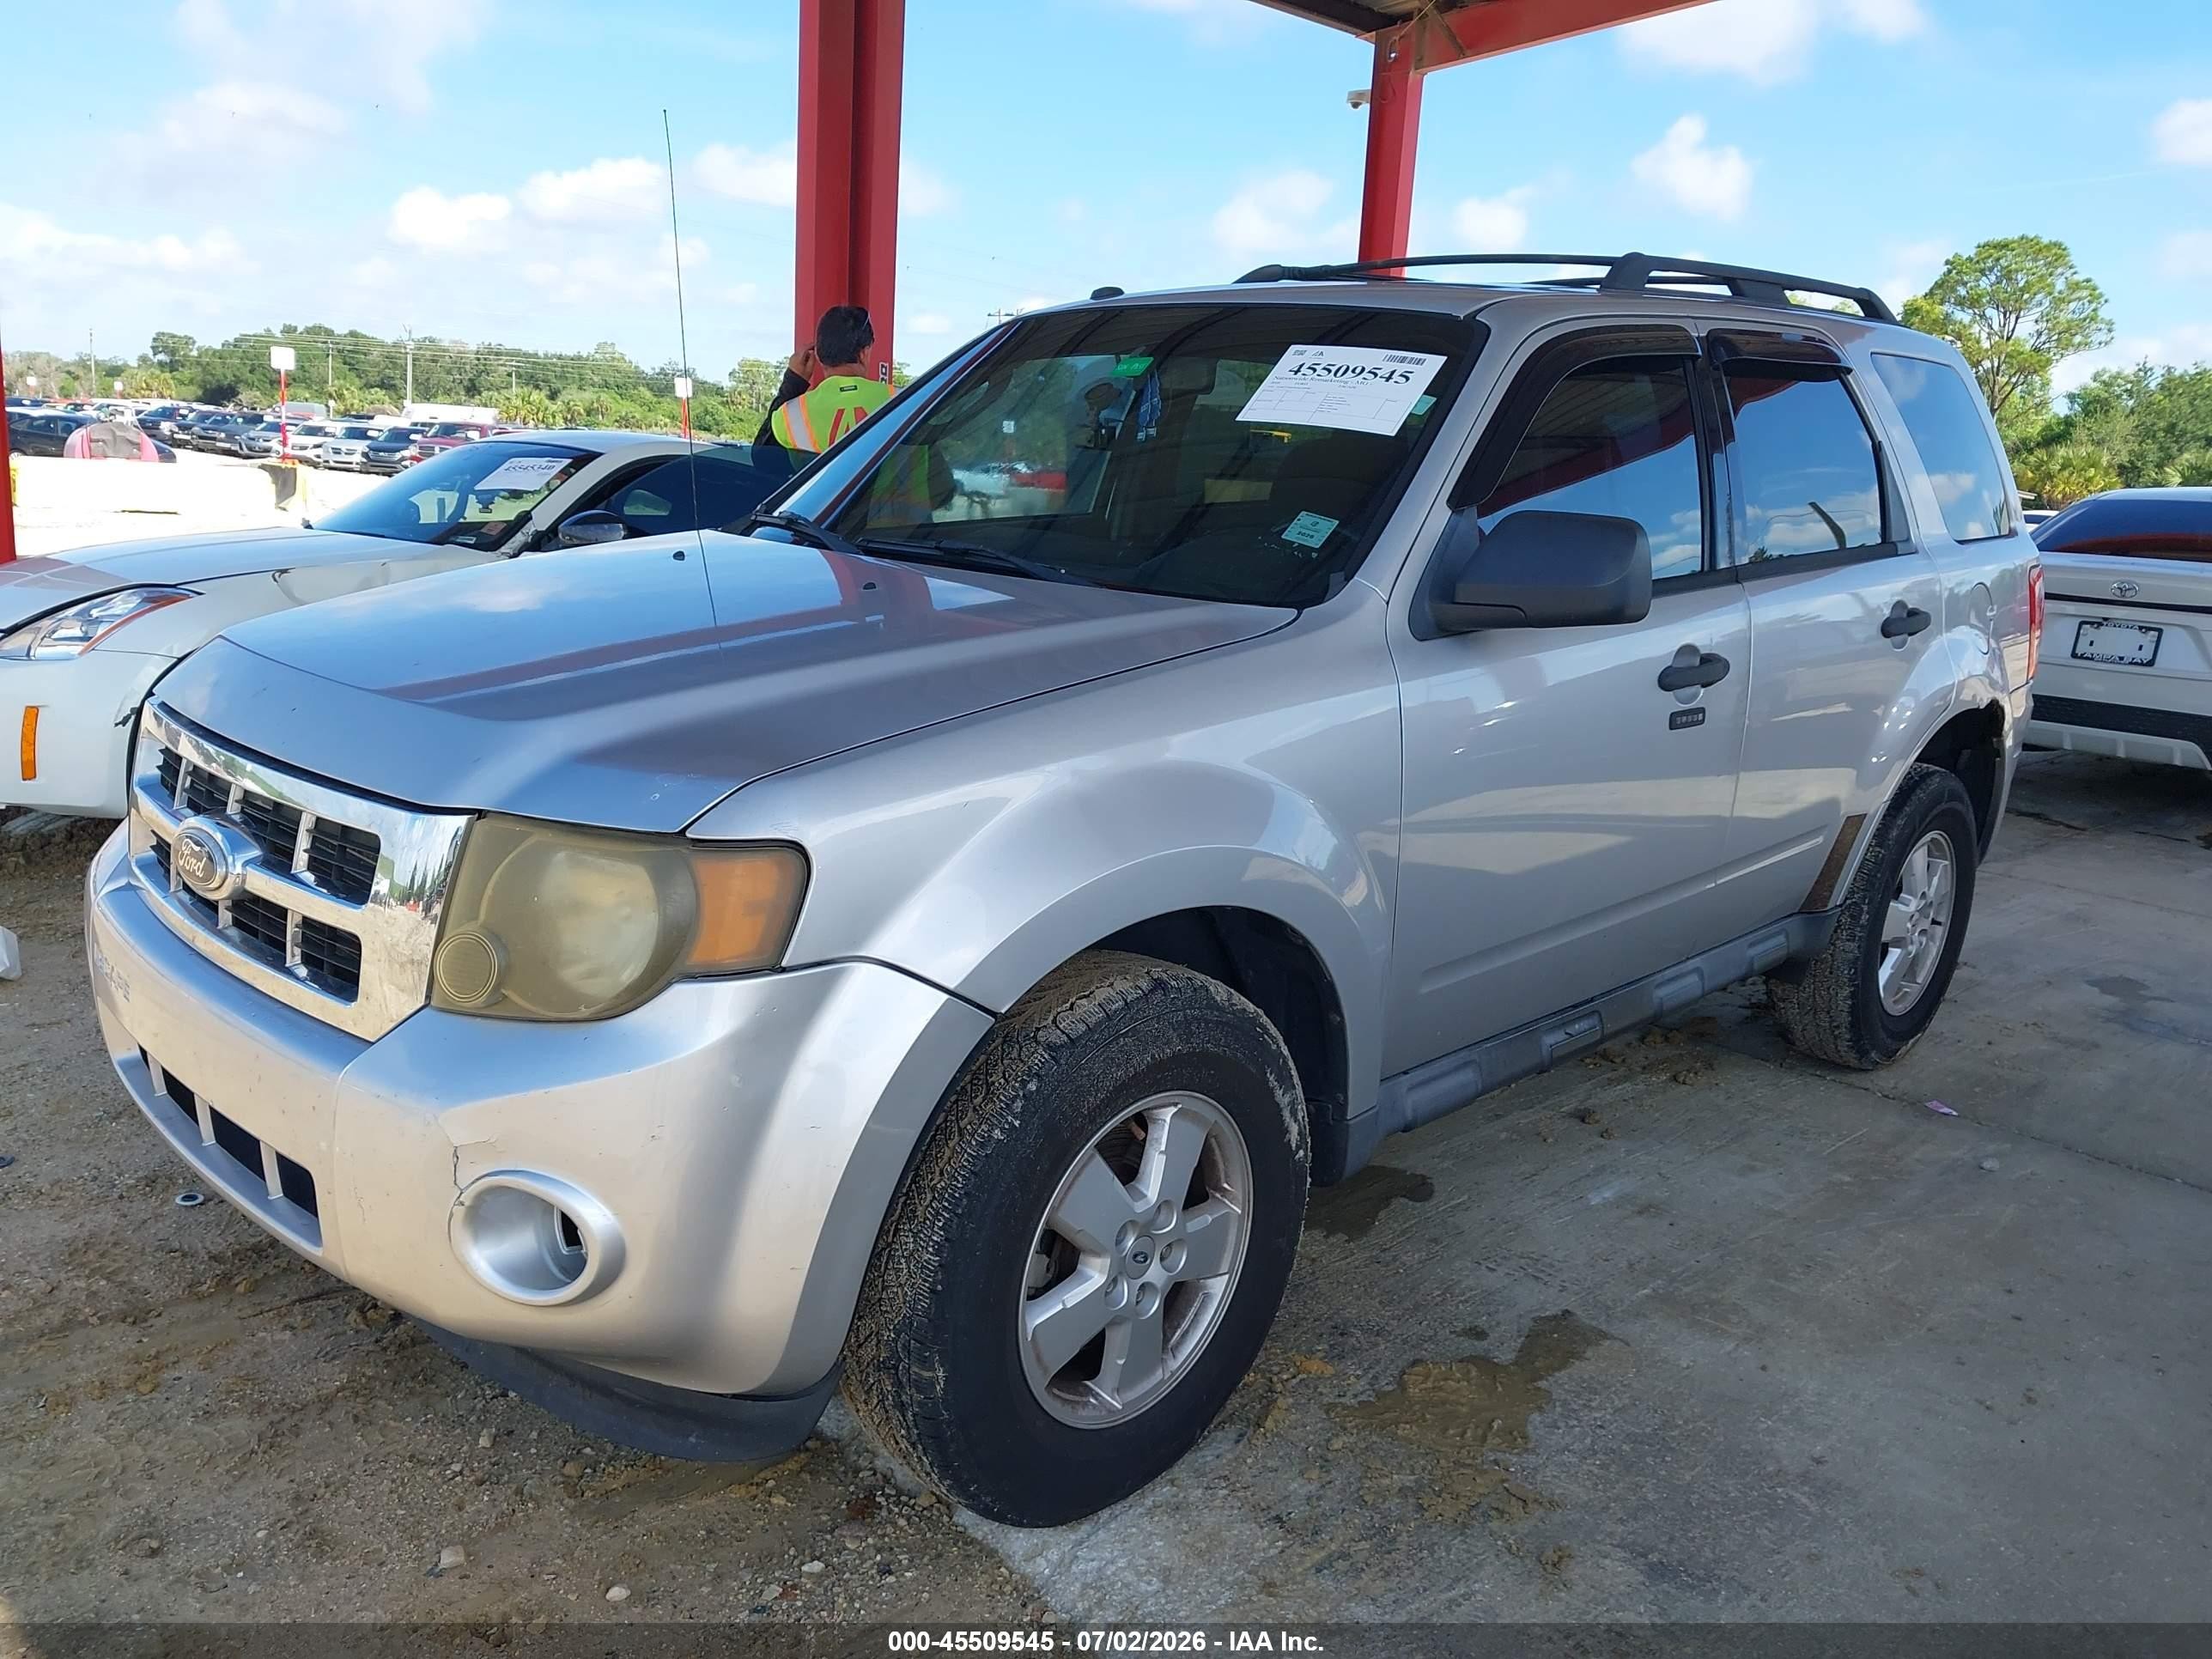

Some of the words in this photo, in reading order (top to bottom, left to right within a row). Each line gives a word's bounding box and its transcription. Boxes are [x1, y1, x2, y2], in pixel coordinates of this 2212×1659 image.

[1287, 361, 1415, 386] 45509545
[2075, 652, 2120, 662] TAMPA
[178, 838, 207, 878] Ford
